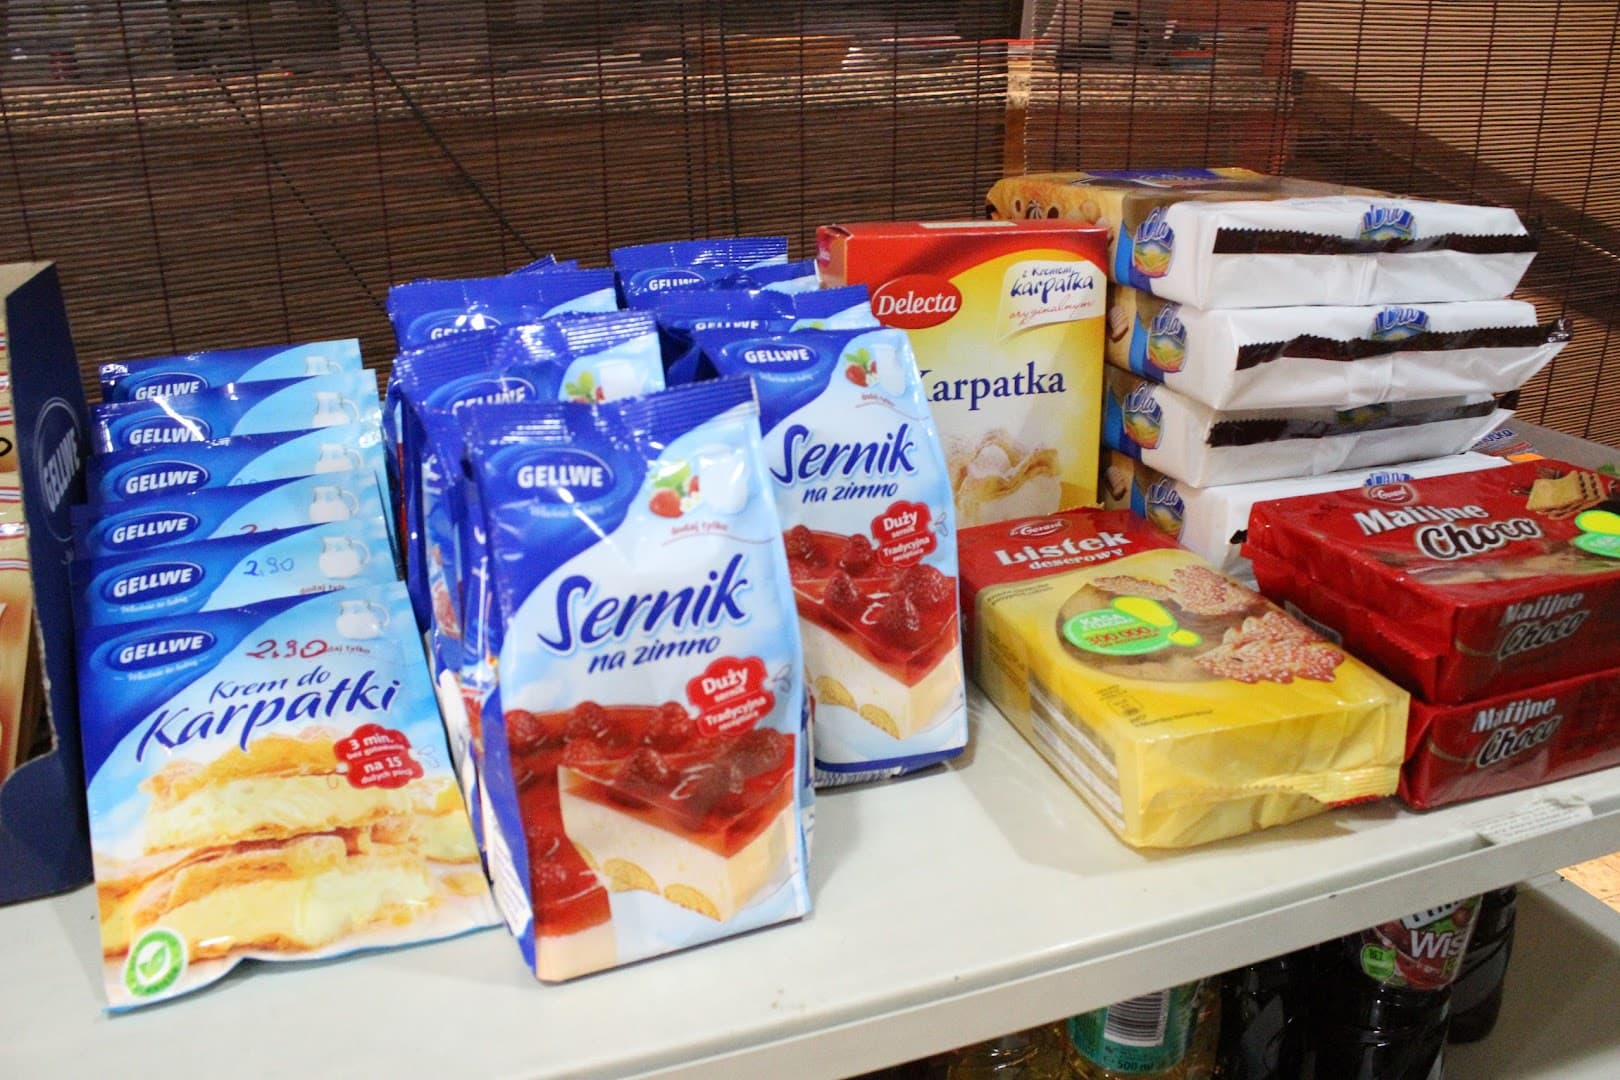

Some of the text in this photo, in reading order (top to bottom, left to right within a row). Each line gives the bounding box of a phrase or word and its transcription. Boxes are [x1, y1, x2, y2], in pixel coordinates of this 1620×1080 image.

[877, 291, 957, 317] Delecta
[744, 348, 810, 363] GELLWE
[135, 381, 200, 401] GELLWE
[129, 426, 204, 445] GELLWE
[769, 423, 915, 483] Sernik
[125, 470, 200, 495] GELLWE
[517, 465, 603, 489] GELLWE
[802, 482, 899, 504] na zimno
[111, 518, 189, 544] GELLWE
[883, 511, 918, 532] Duży
[1353, 504, 1490, 536] Mafijne
[994, 531, 1133, 566] Listek
[1418, 518, 1543, 560] Choco
[1029, 548, 1124, 570] deserowy
[113, 568, 193, 598] GELLWE
[537, 554, 748, 651] Sernik
[119, 635, 204, 664] GELLWE
[1498, 610, 1590, 661] Choco
[588, 636, 722, 675] na zimno
[209, 665, 331, 703] Krem do
[701, 667, 749, 696] Duży
[136, 670, 401, 762] Karpatki
[1472, 698, 1556, 733] Mafijne
[349, 733, 395, 750] 3 min.
[1476, 716, 1562, 767] Choco
[364, 756, 402, 773] na 15
